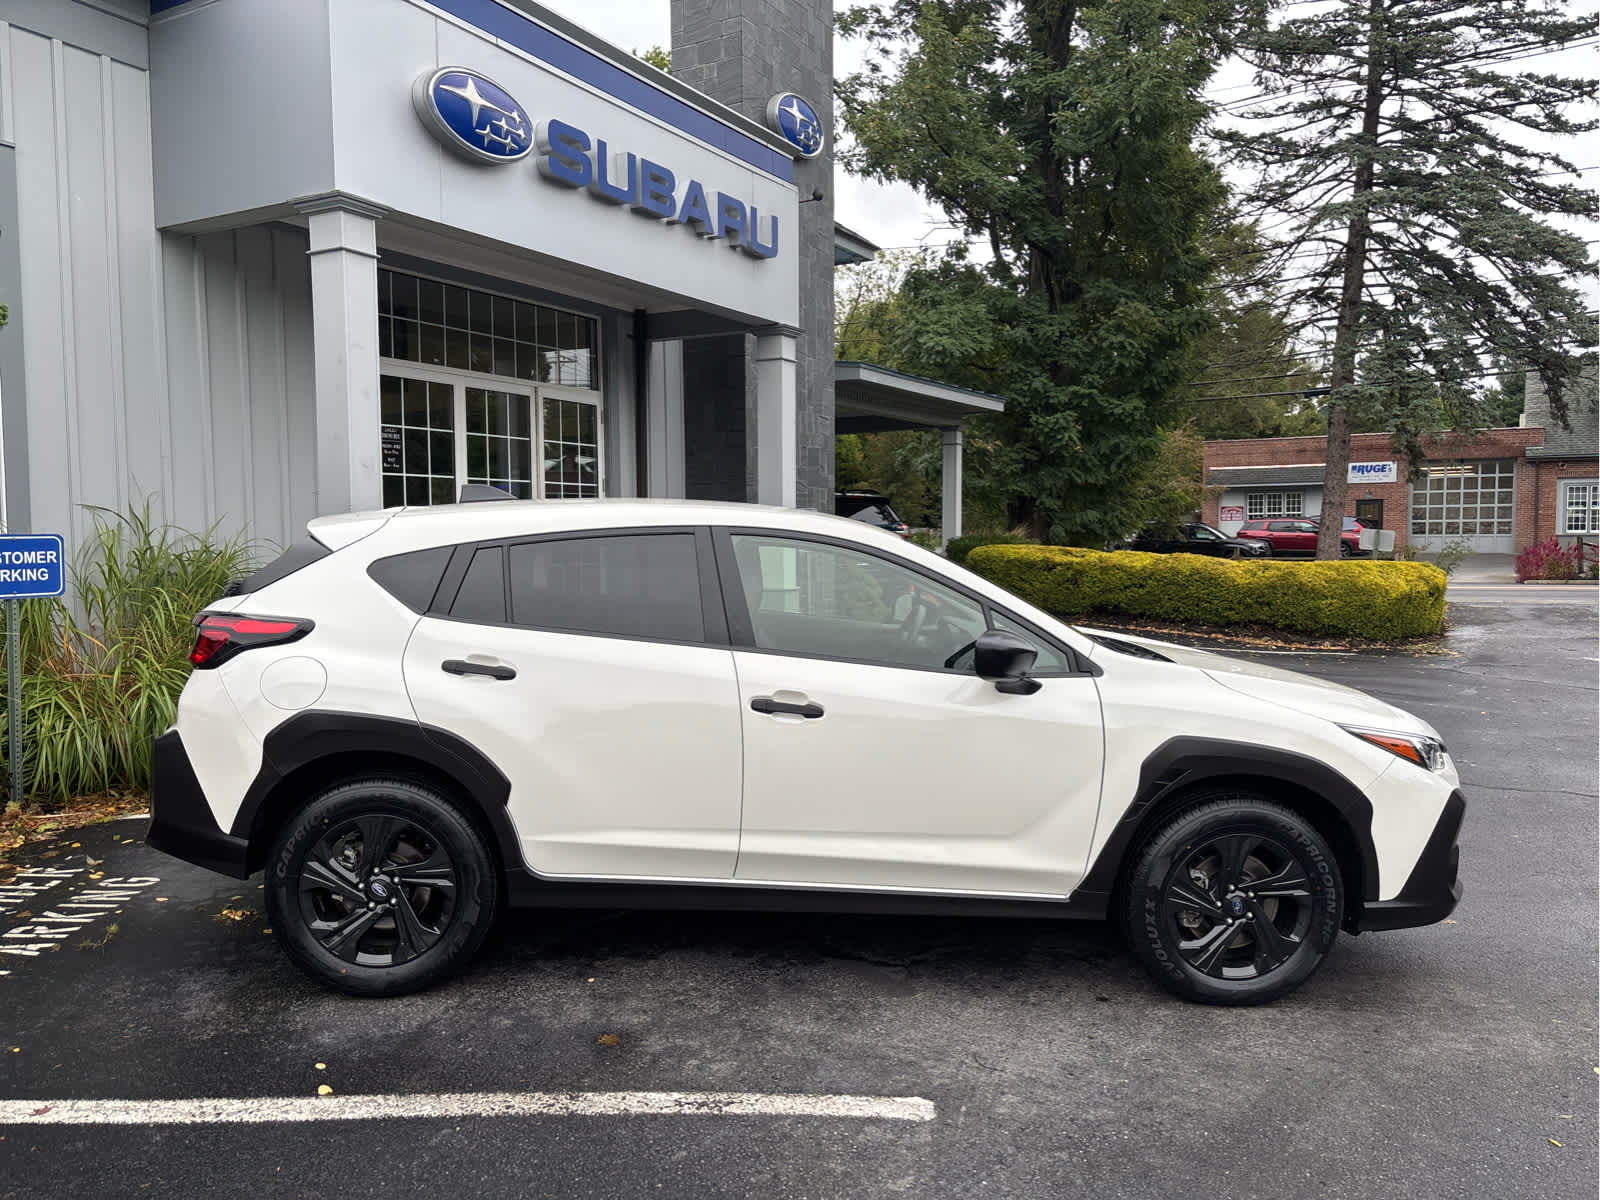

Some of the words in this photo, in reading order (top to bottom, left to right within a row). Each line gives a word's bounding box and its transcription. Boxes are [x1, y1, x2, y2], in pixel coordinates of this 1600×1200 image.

[542, 119, 779, 259] SUBARU
[0, 551, 57, 564] TOMER
[0, 877, 161, 976] ARKING
